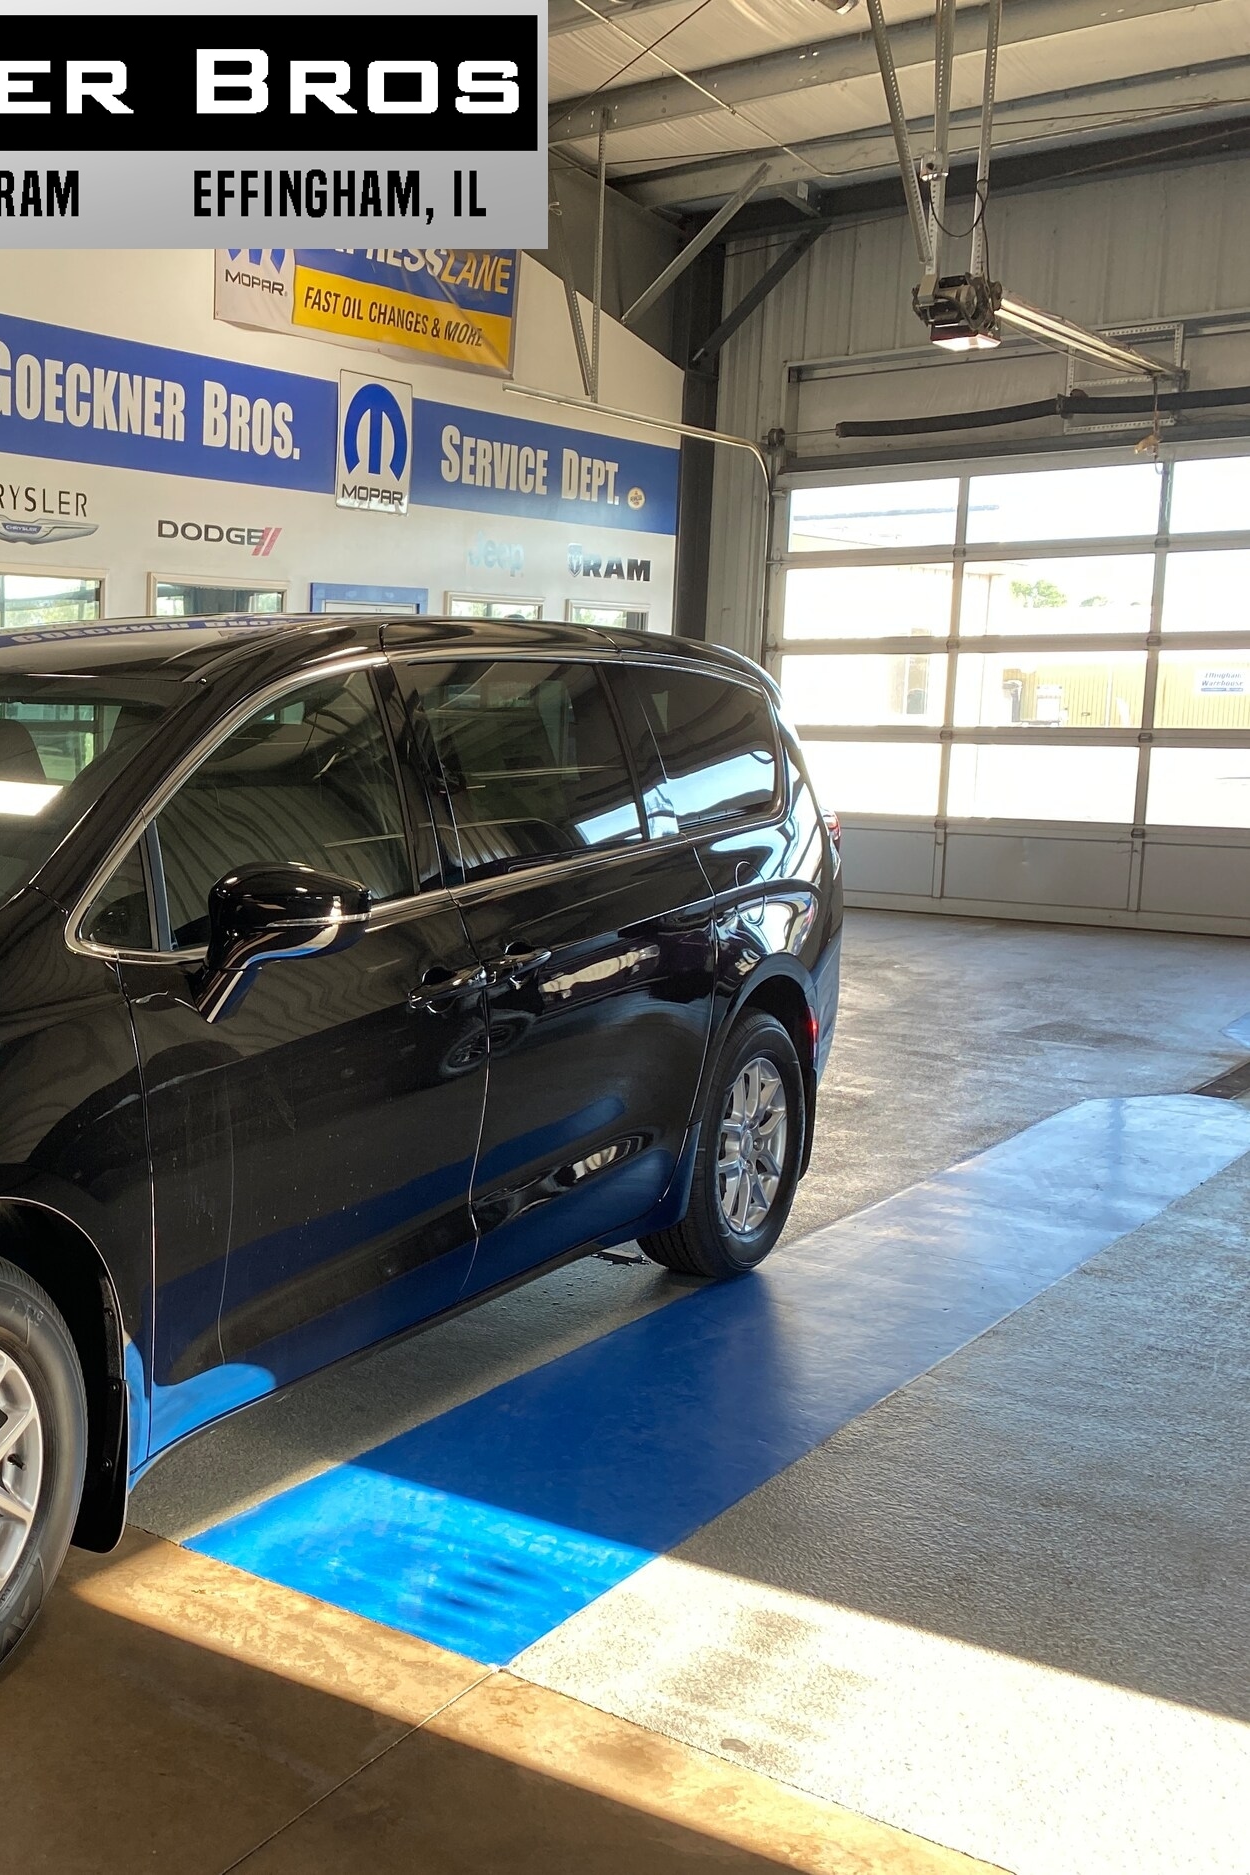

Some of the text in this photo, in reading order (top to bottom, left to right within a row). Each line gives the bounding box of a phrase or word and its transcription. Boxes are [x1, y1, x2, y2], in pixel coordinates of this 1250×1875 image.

[225, 268, 284, 297] MOPAR
[303, 286, 484, 347] FAST OIL CHANGES & MORE
[203, 380, 301, 460] BROS.
[440, 424, 620, 506] SERVICE DEPT.
[342, 483, 404, 506] MOPAR
[157, 519, 266, 547] DODGE
[468, 529, 525, 578] Jeep
[582, 552, 652, 582] RAM
